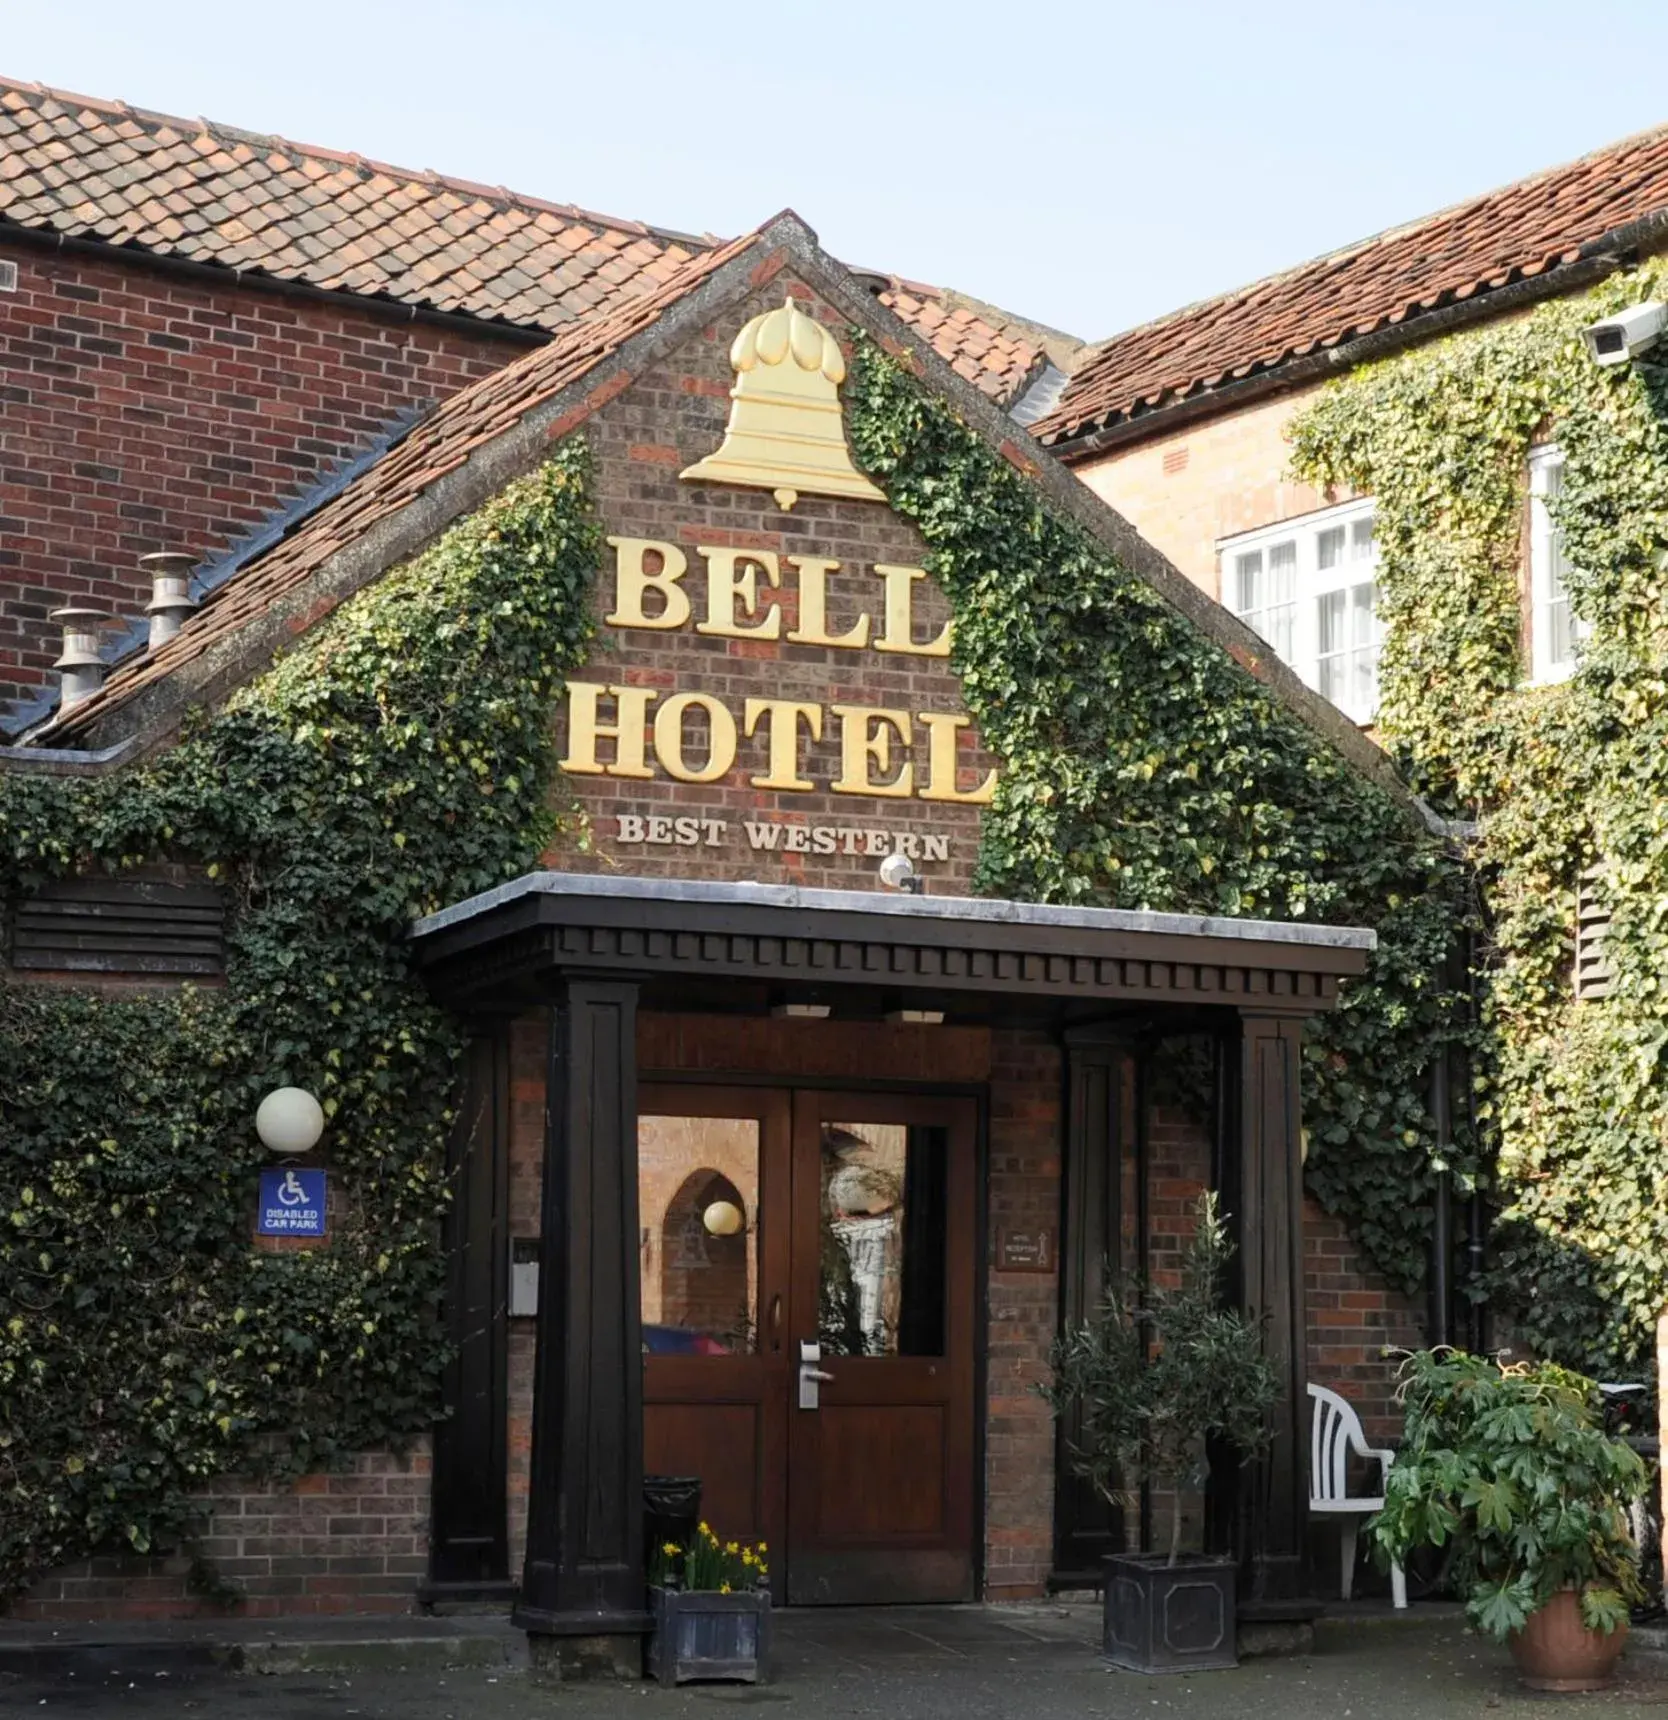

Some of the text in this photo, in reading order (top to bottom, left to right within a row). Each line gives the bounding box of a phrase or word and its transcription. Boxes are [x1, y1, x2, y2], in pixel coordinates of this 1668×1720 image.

[605, 535, 953, 656] BELL
[558, 681, 998, 804] HOTEL
[616, 814, 950, 861] BEST WESTERN
[265, 1219, 318, 1229] CAR PARK
[266, 1209, 318, 1219] DISABLED
